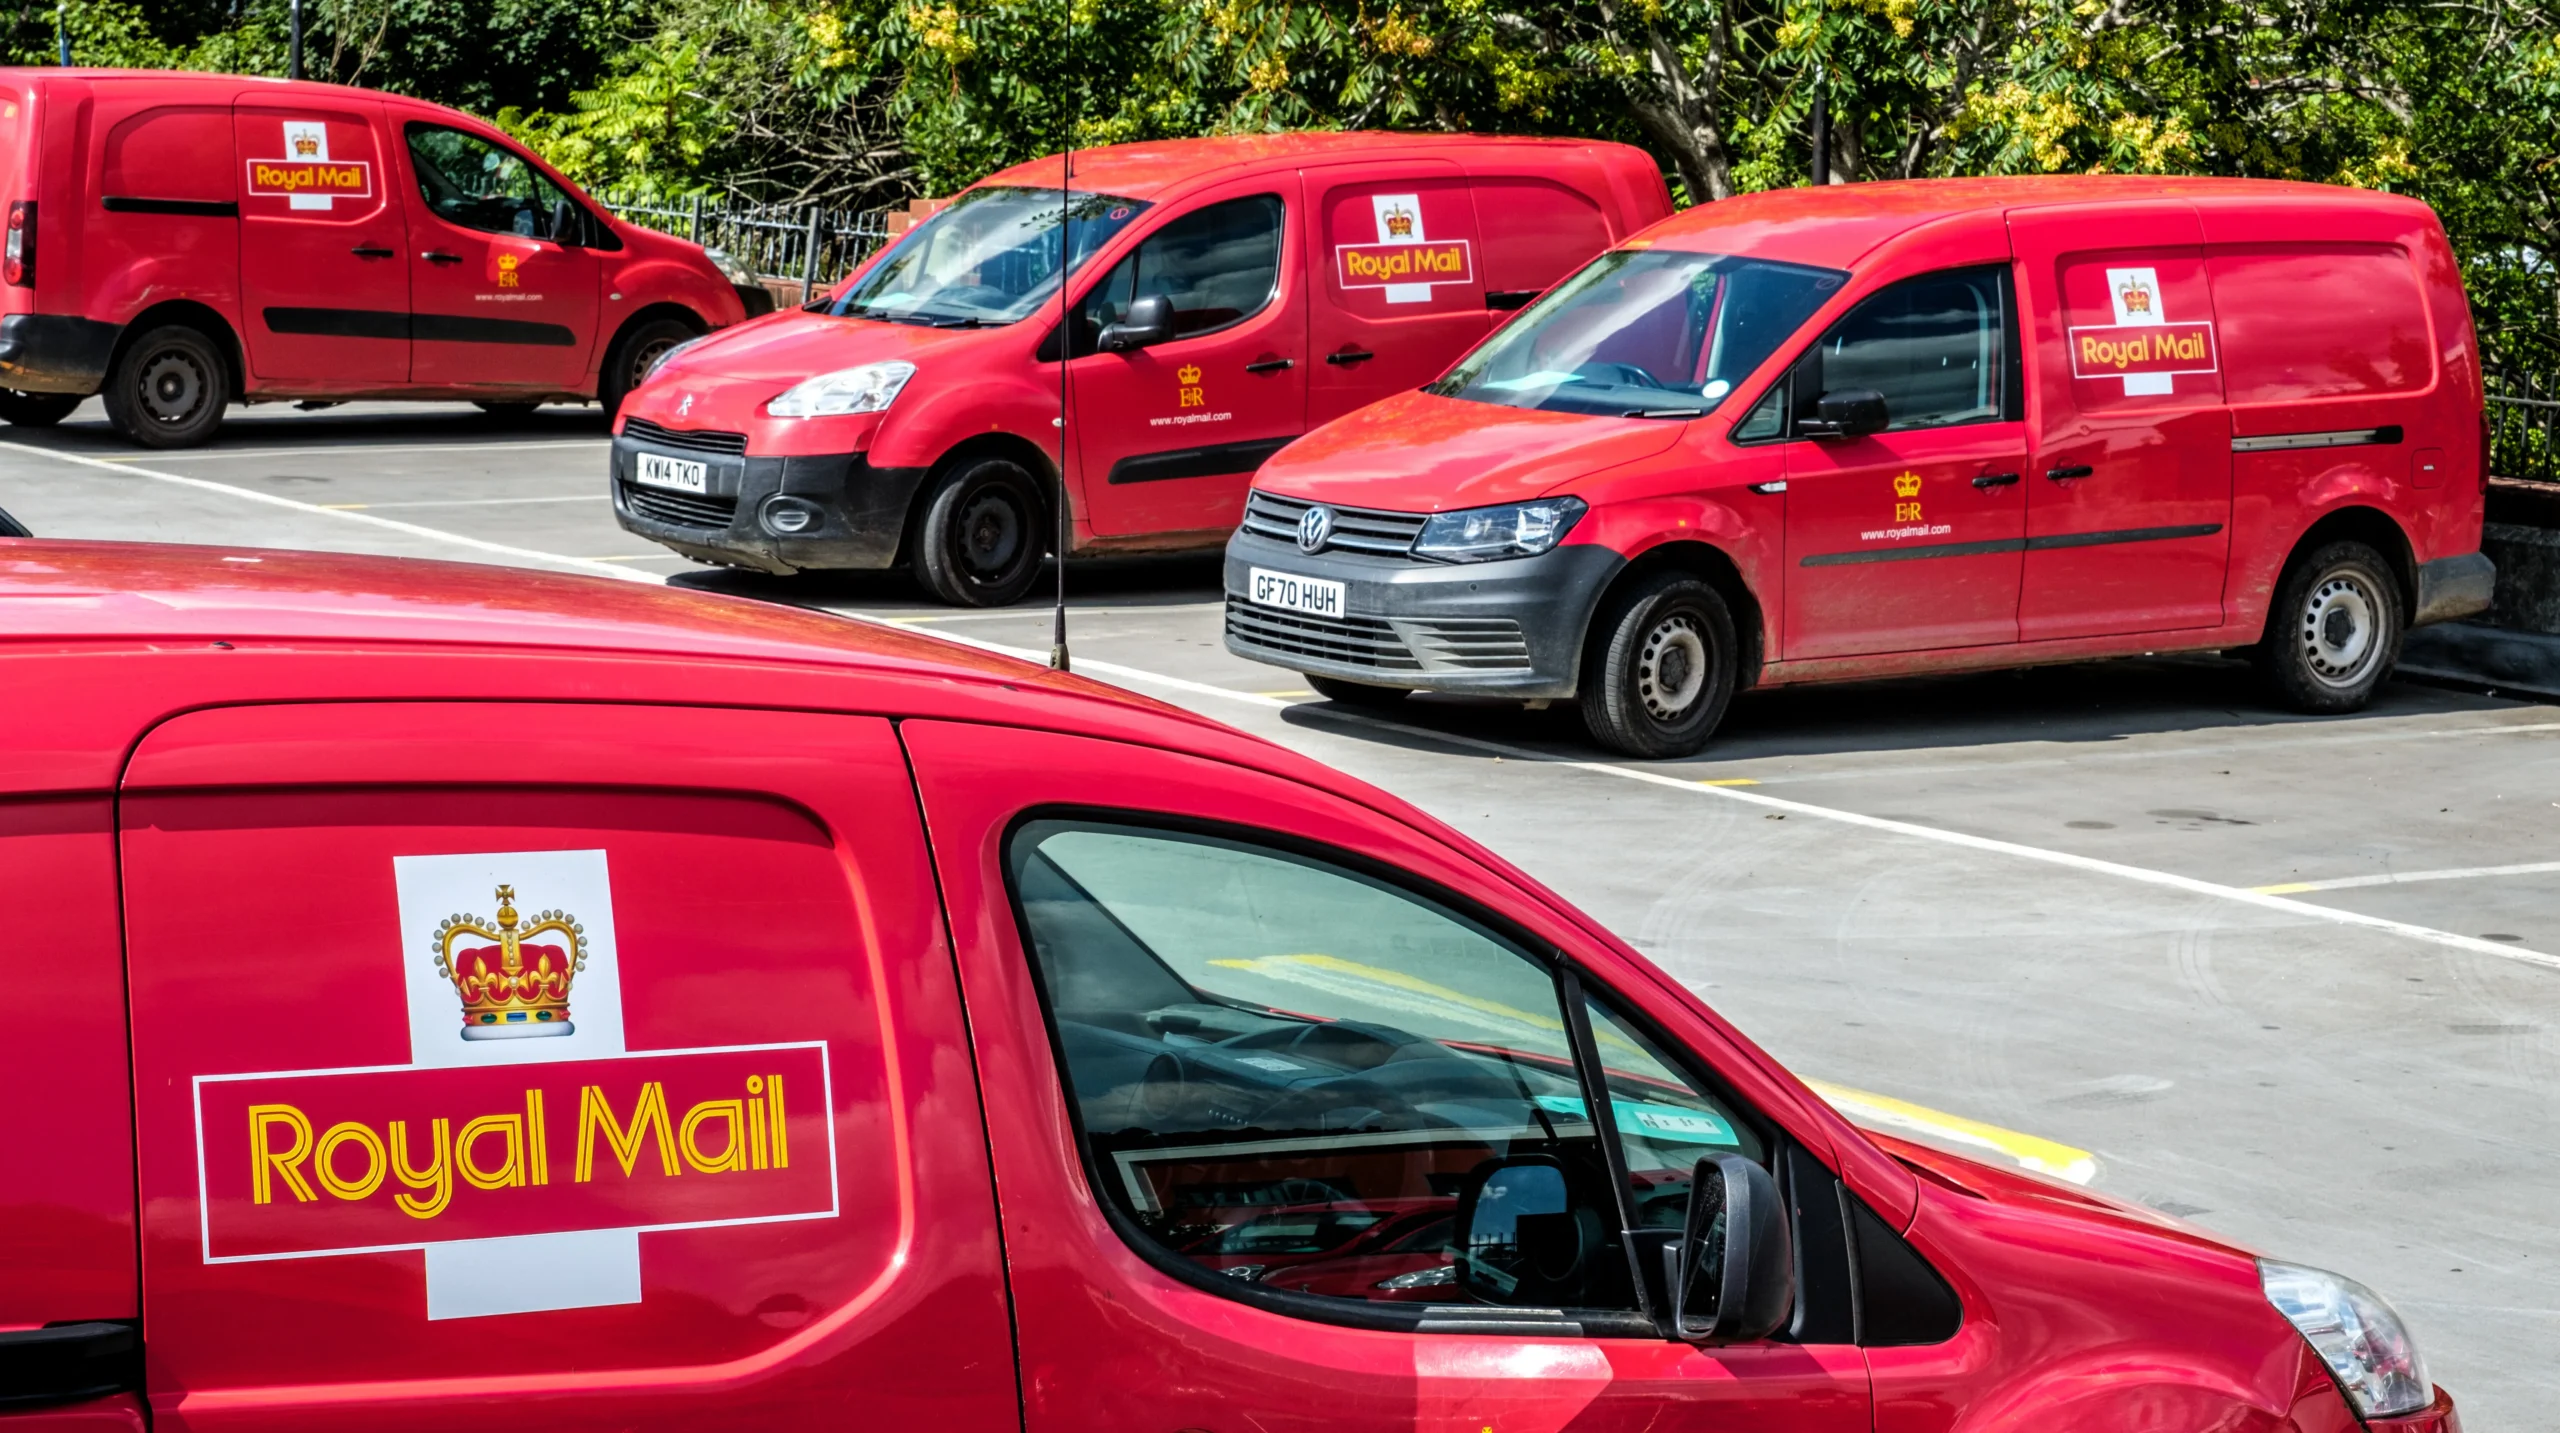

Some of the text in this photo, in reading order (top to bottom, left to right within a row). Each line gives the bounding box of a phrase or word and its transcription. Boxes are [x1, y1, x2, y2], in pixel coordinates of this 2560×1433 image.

[256, 165, 361, 191] Royal Mail
[1347, 247, 1462, 281] Royal Mail
[475, 293, 543, 303] www.royalmail.com
[2081, 332, 2206, 369] Royal Mail
[1150, 411, 1232, 426] www.royalmail.com
[646, 457, 700, 486] KW14 TKO
[1861, 524, 1951, 540] www.royalmail.com
[1257, 575, 1336, 613] GF70 HUH
[249, 1074, 789, 1219] Royal Mail
